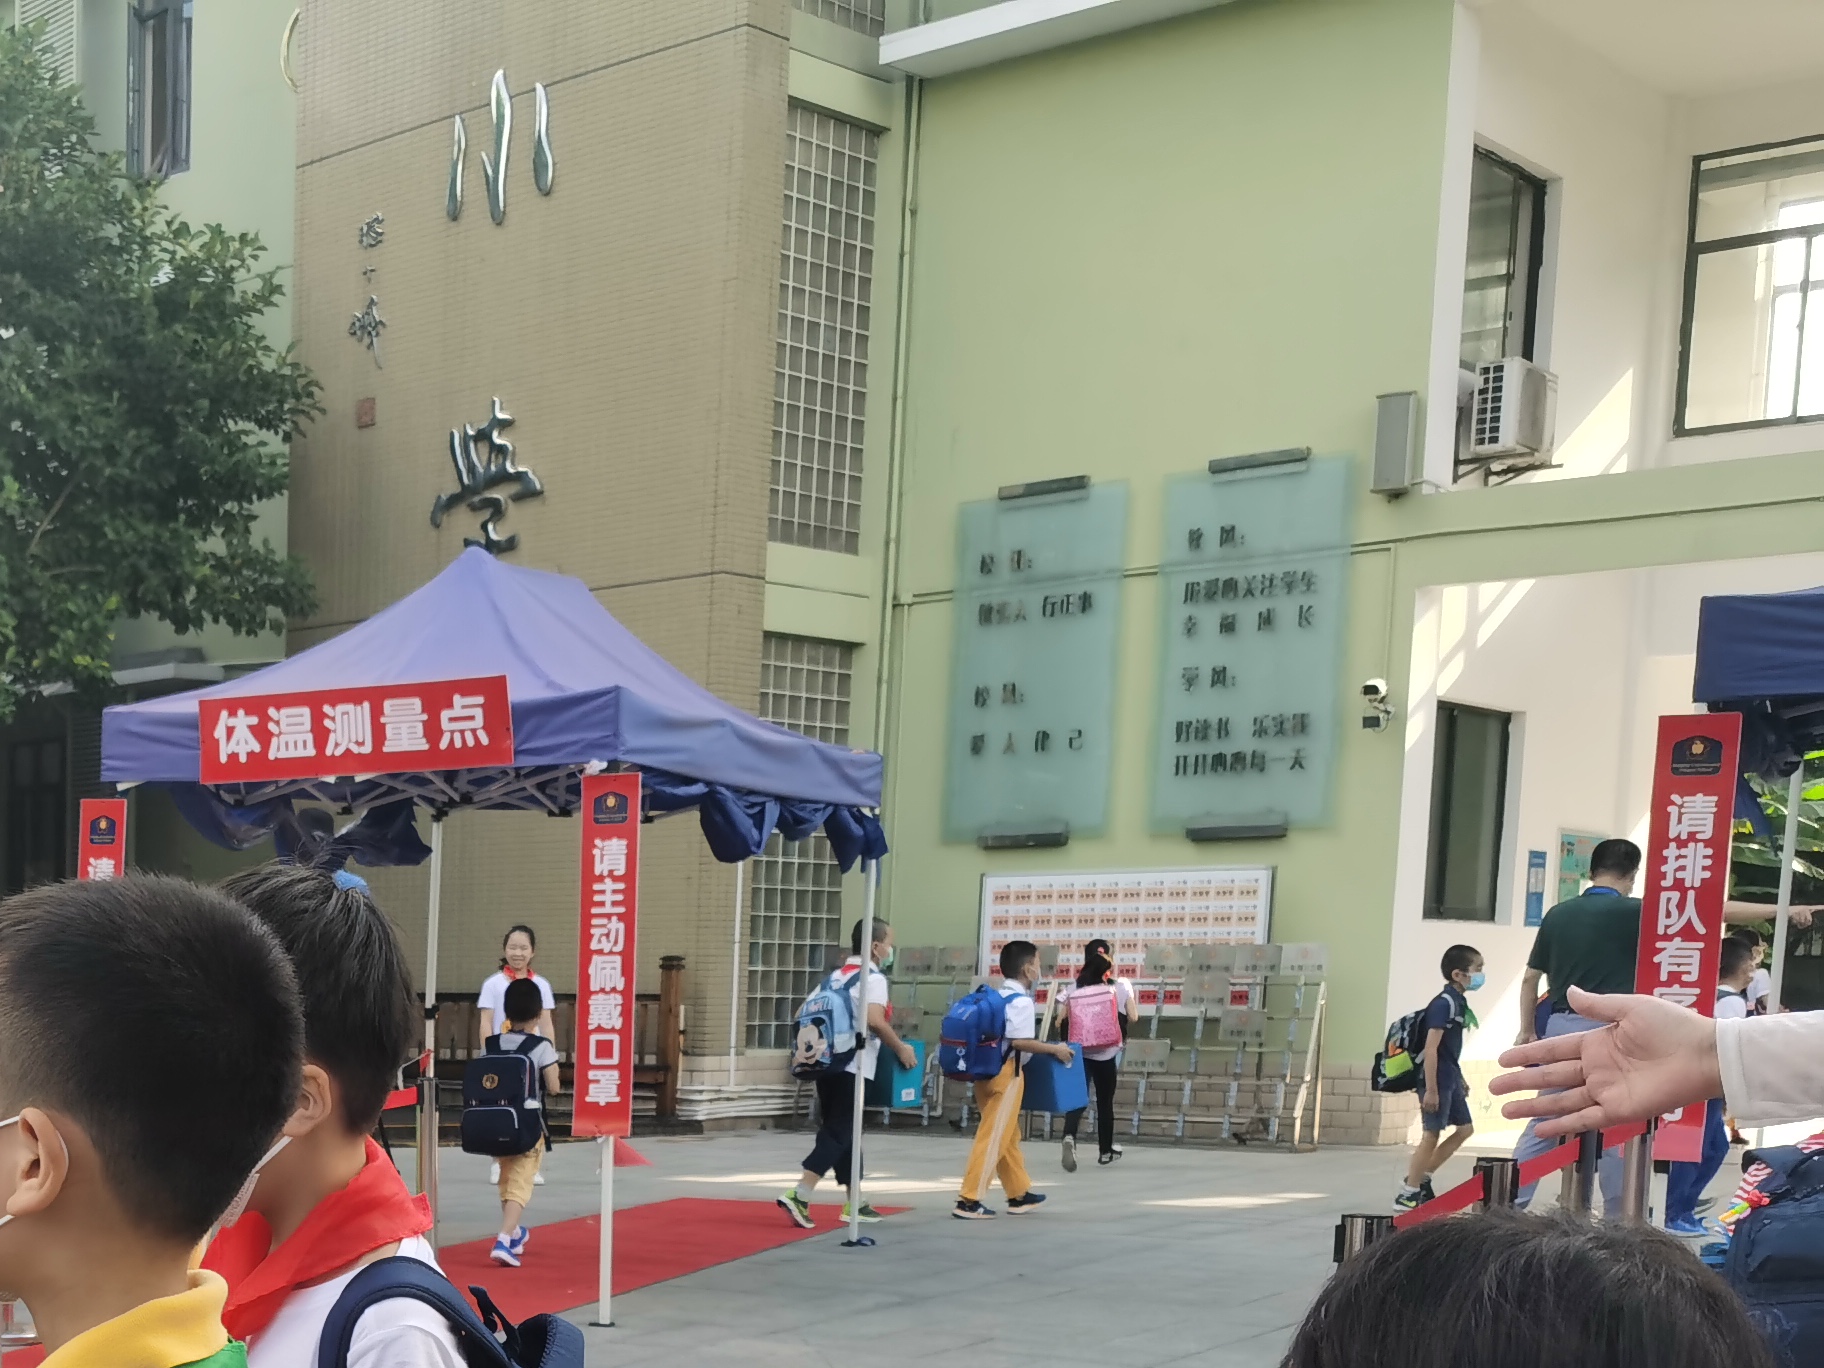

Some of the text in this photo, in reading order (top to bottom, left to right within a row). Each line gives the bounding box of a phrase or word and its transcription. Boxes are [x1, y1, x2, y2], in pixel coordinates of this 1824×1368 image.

[213, 695, 489, 764] 体温测量点
[586, 836, 632, 1107] 请主动佩戴口罩
